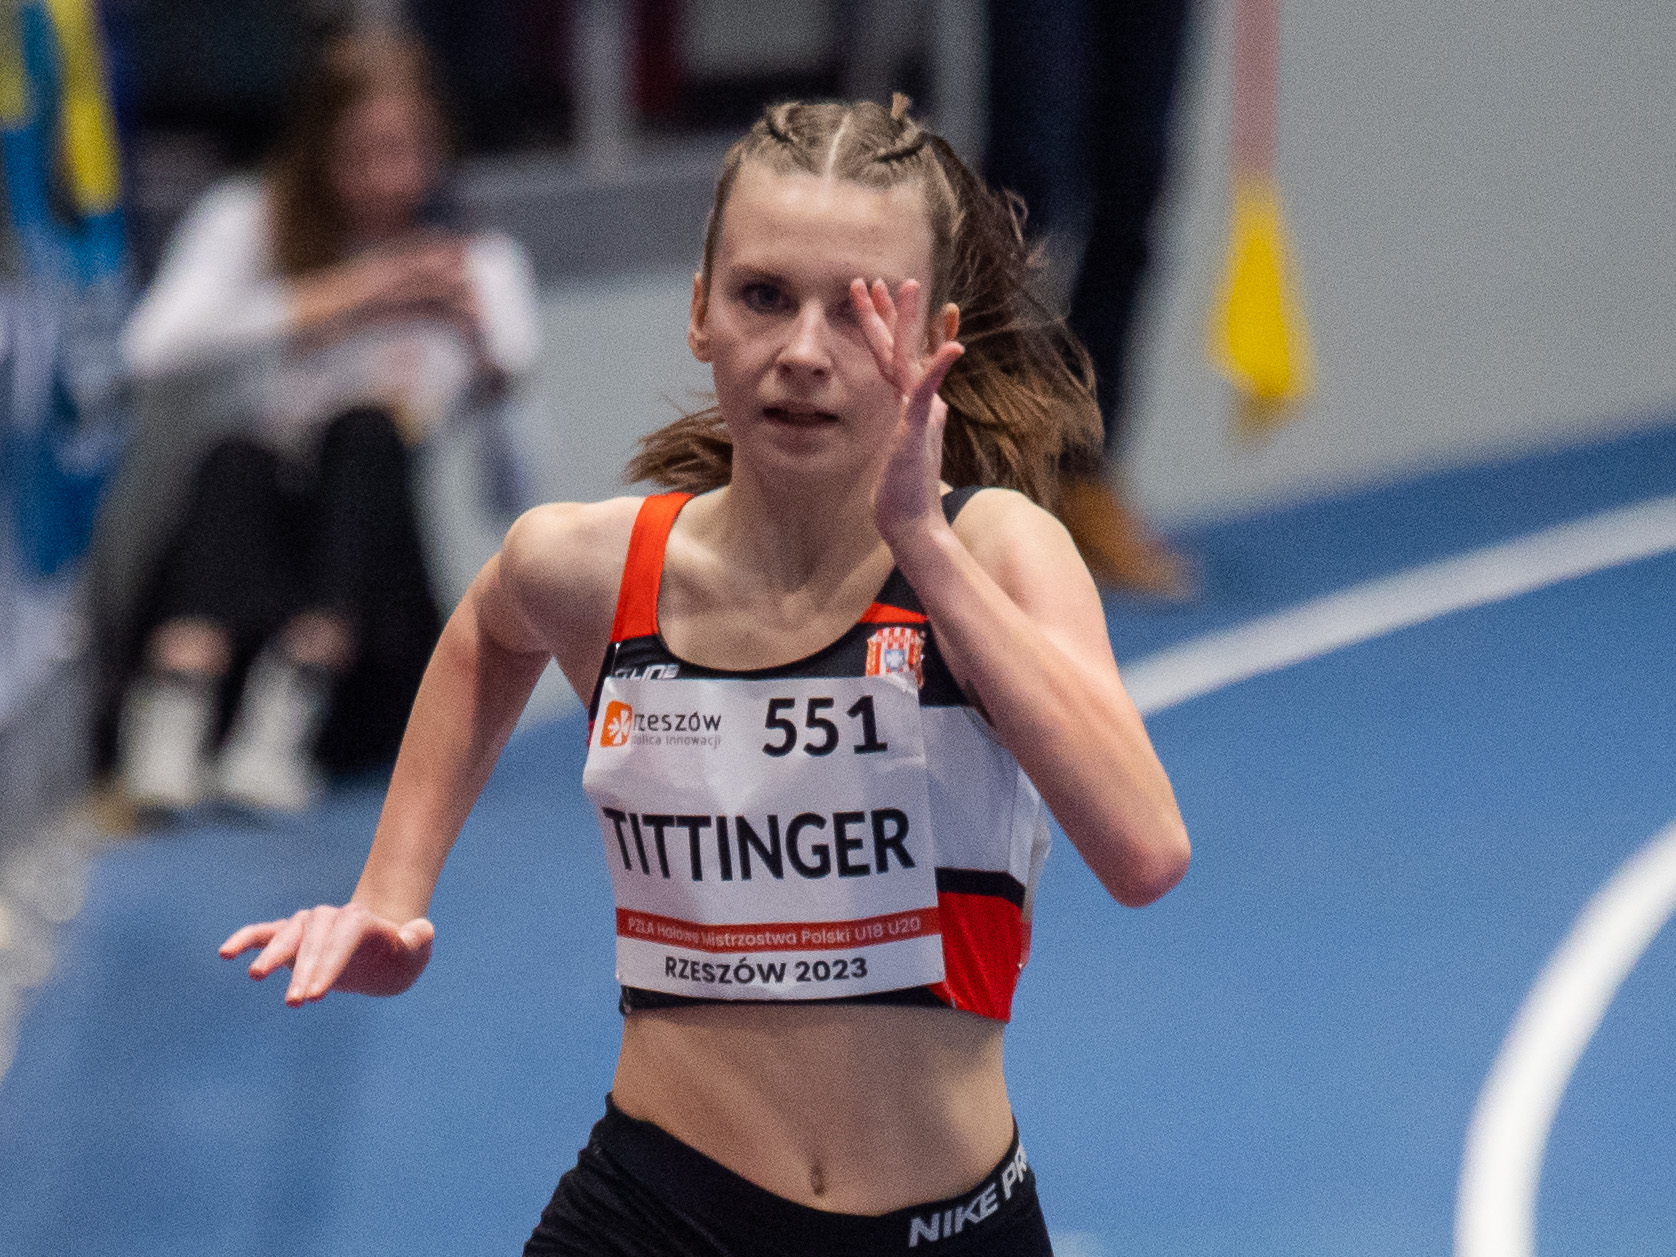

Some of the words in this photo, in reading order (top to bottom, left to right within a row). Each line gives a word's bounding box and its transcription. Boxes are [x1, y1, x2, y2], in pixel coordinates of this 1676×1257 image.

[762, 695, 888, 757] 551
[601, 806, 916, 881] TITTINGER
[627, 917, 655, 935] PZLA
[701, 930, 798, 947] Mistrzostwa
[801, 928, 851, 945] Polski
[854, 923, 885, 941] U18
[888, 916, 922, 935] U20
[664, 955, 787, 984] RZESZÓW
[794, 957, 869, 982] 2023
[908, 1183, 998, 1248] NIKE
[1001, 1143, 1028, 1200] PR
